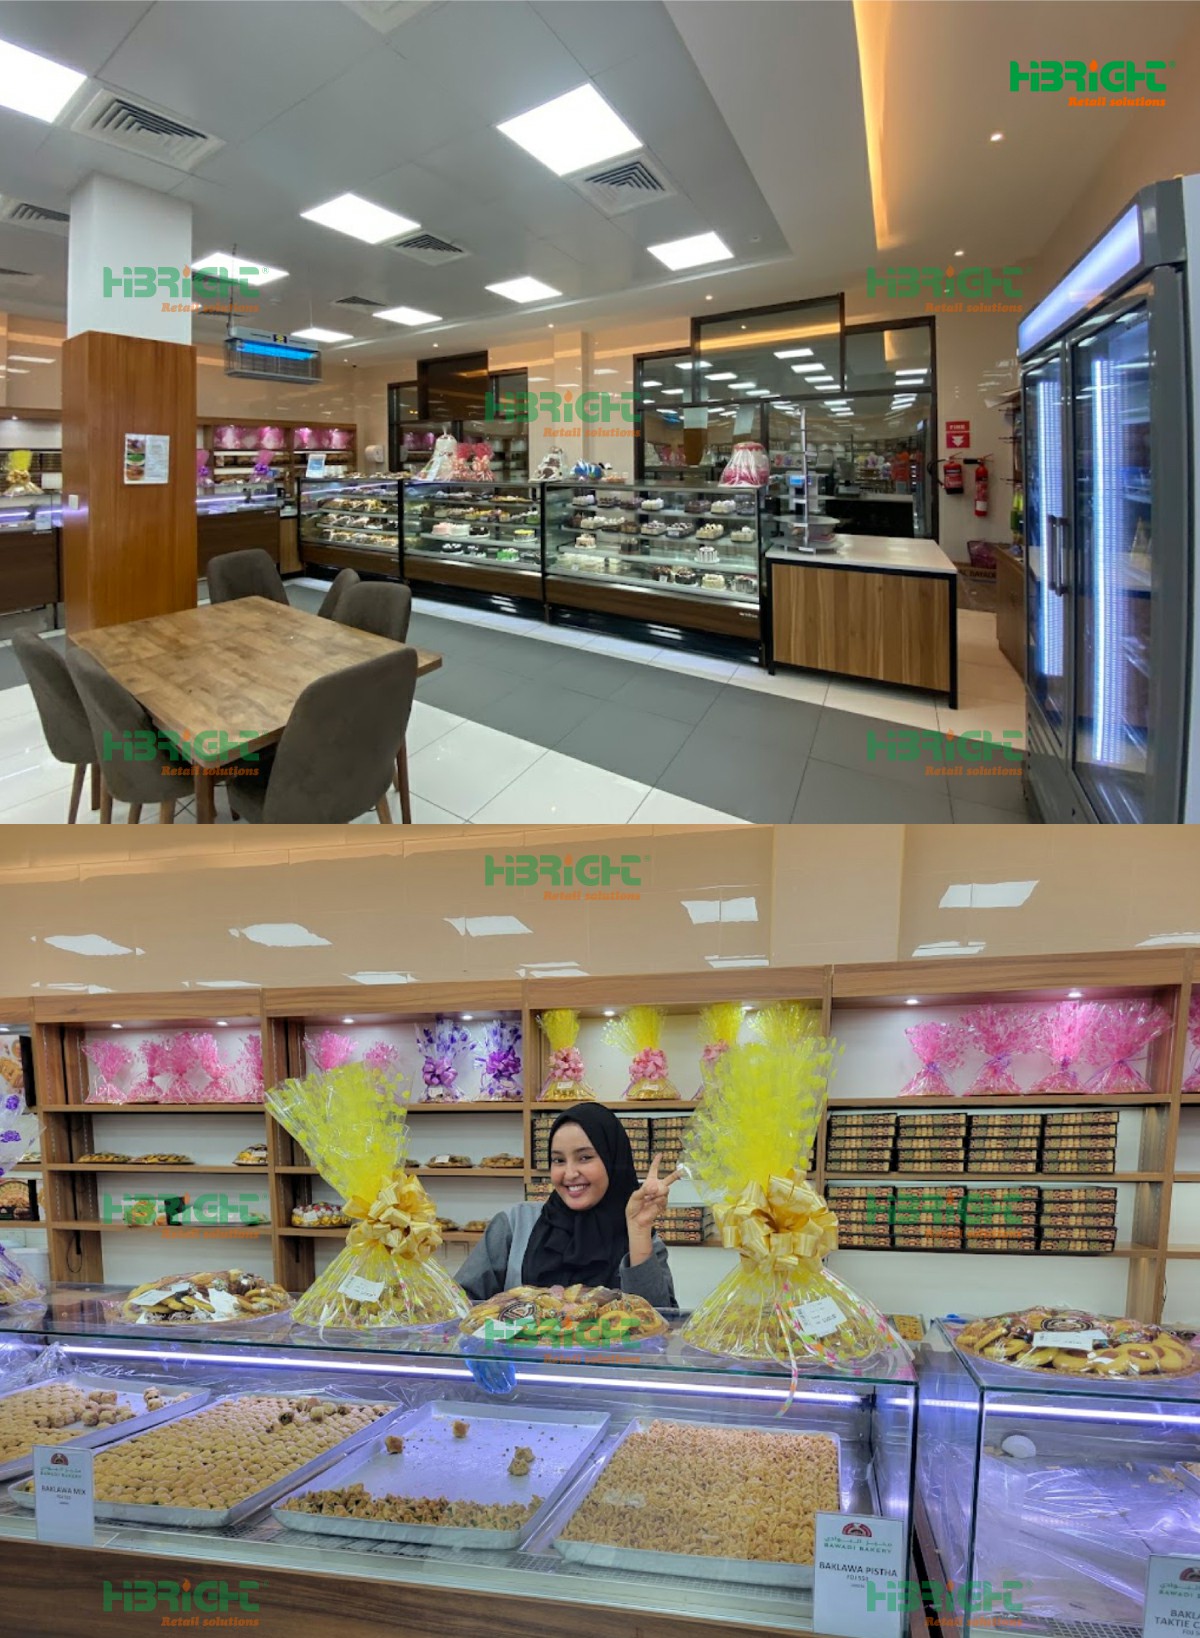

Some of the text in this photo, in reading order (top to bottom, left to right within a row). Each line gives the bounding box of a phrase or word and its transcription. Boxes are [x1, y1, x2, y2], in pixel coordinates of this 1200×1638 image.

[42, 1484, 72, 1493] BAKLAWA
[820, 1562, 898, 1577] BAKLAWA PISTHA
[1159, 1590, 1193, 1598] BAWADI
[1155, 1616, 1190, 1628] TAKTIE
